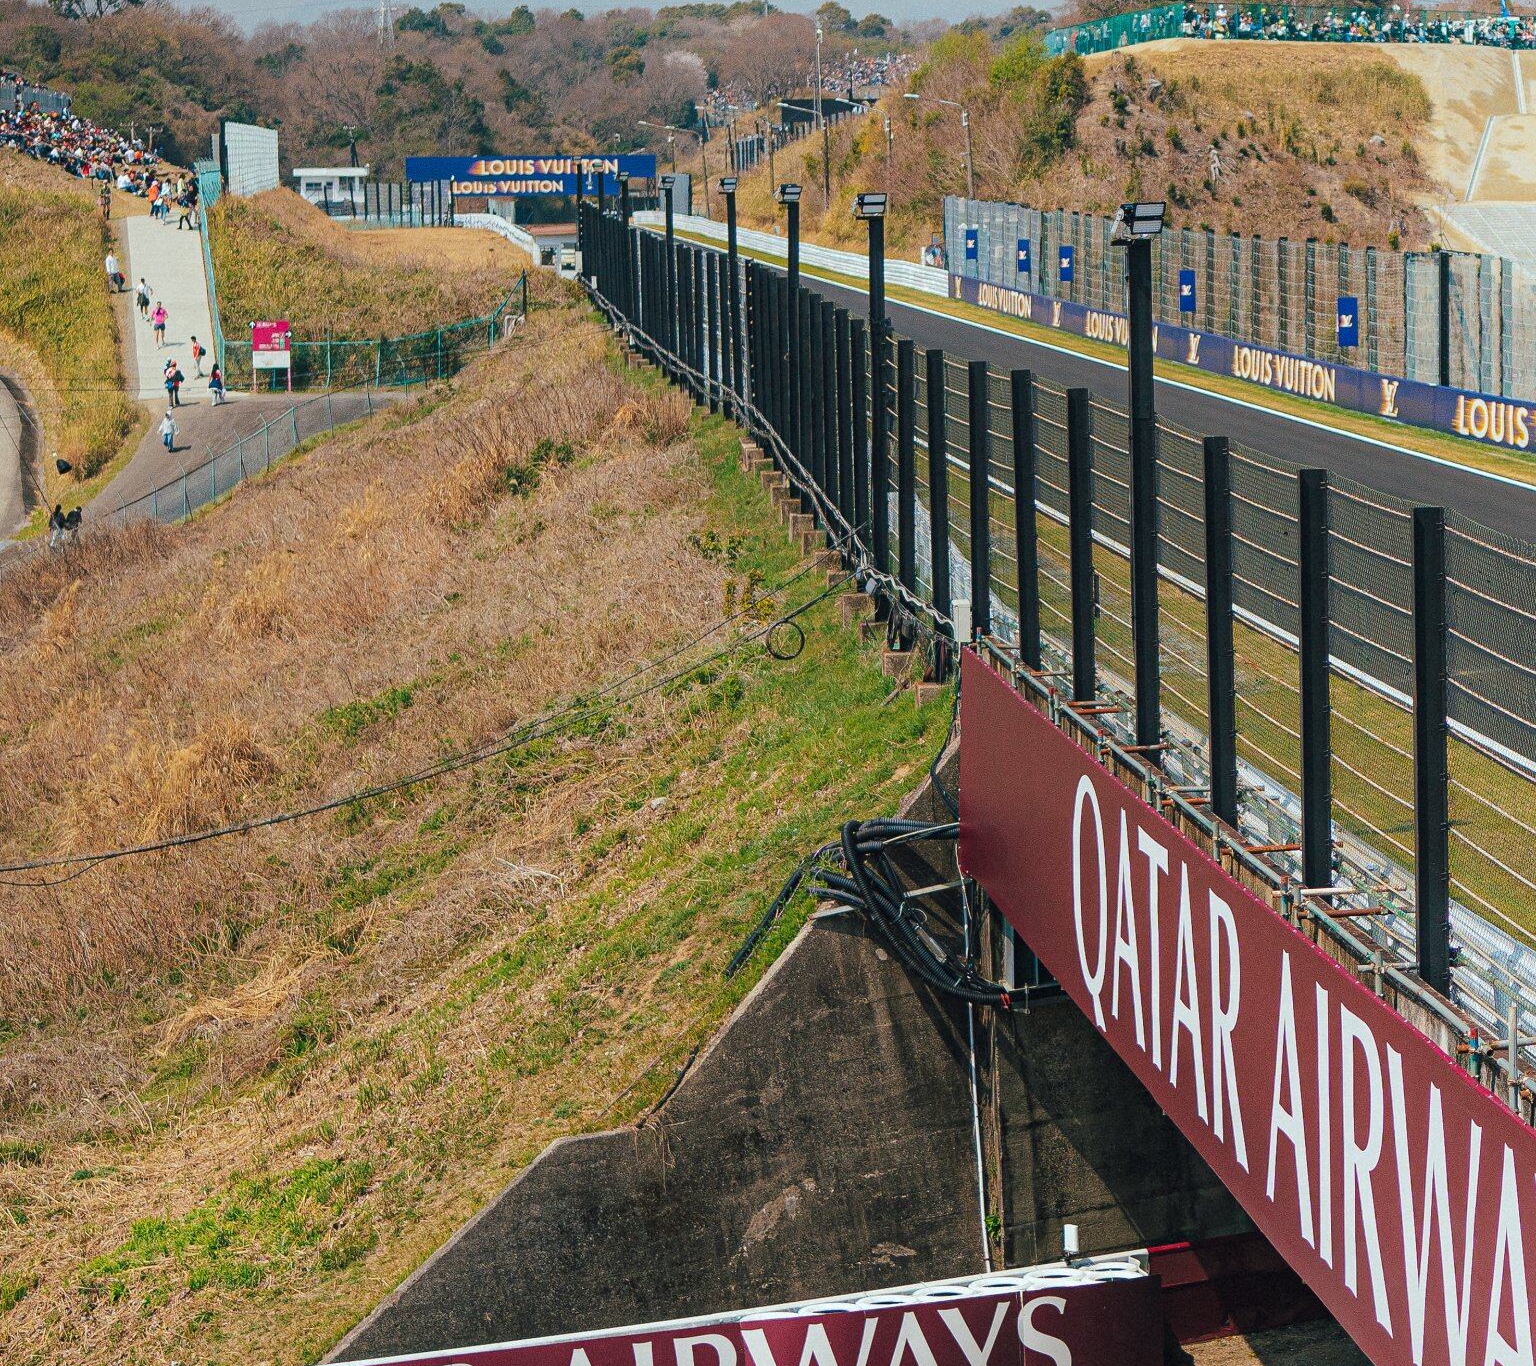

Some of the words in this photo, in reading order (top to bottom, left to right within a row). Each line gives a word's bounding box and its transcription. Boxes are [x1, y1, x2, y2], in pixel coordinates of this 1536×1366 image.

[480, 160, 534, 176] LOUIS
[540, 159, 618, 175] VUITON
[453, 180, 497, 194] LOUIS
[501, 179, 563, 195] VUITTON
[978, 282, 998, 310] LOUIS
[998, 289, 1032, 318] VUITTON
[1086, 310, 1114, 342] LOUIS
[1233, 344, 1273, 385] LOUIS
[1273, 354, 1336, 402] VUITTON
[1455, 395, 1530, 448] LOUIS
[1071, 774, 1249, 1175] QATAR
